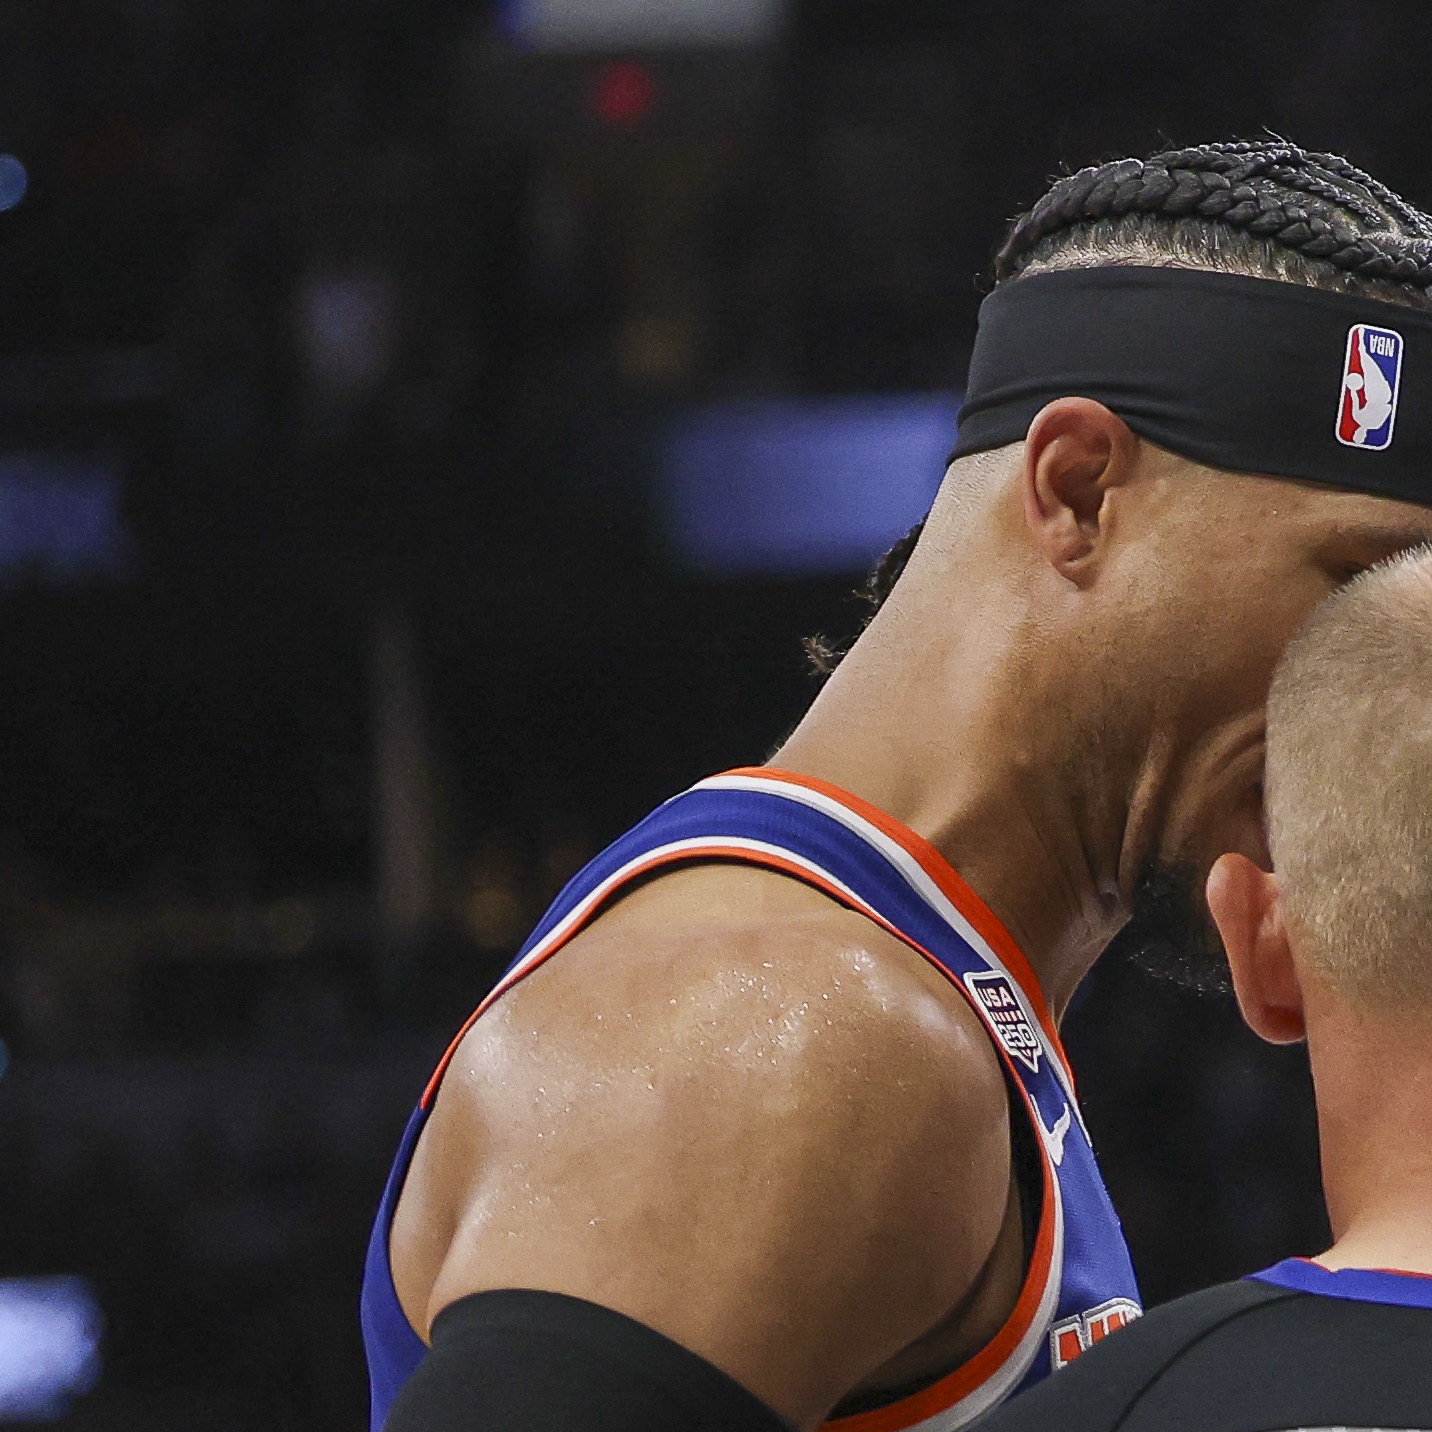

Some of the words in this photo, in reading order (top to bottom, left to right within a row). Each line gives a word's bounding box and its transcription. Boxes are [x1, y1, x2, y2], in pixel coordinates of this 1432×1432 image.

[1369, 334, 1395, 358] NBA
[977, 986, 1016, 1008] USA
[997, 1023, 1037, 1048] 250
